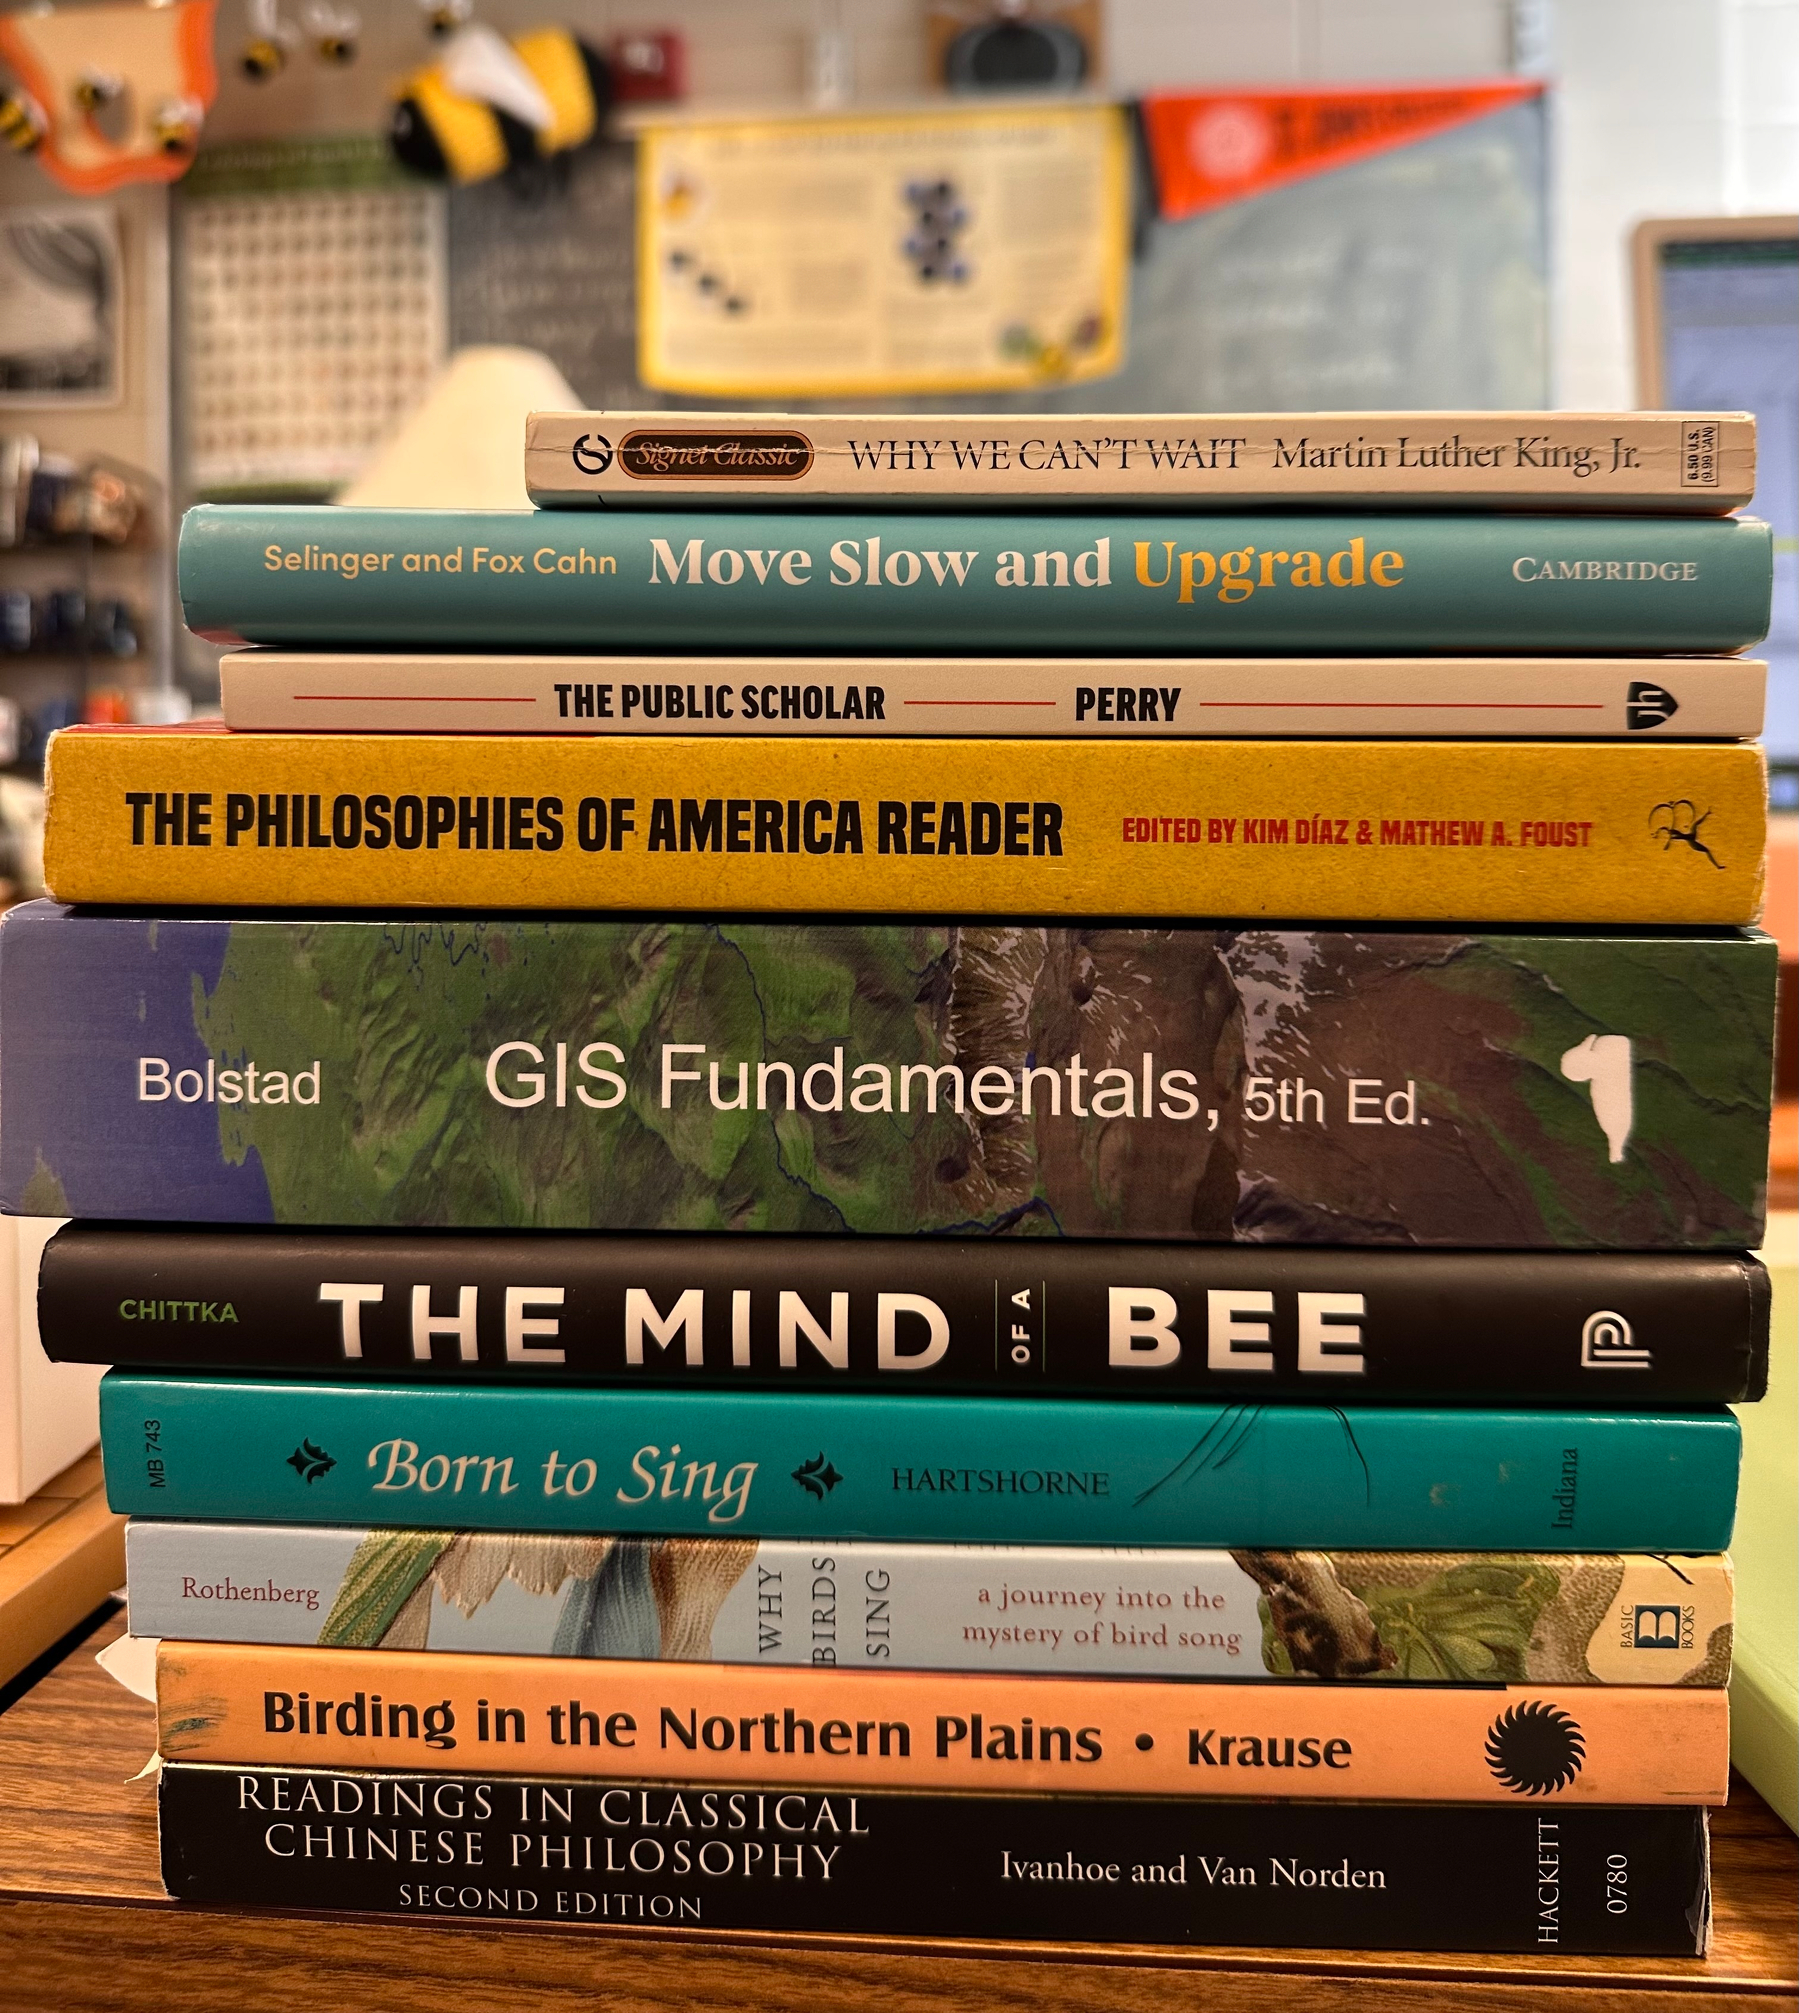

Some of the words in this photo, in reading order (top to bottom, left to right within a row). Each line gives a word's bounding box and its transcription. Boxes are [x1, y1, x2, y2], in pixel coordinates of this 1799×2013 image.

[636, 442, 707, 472] Signet
[713, 441, 797, 466] Classic
[847, 441, 938, 469] WHY
[949, 441, 1010, 469] WE
[1019, 438, 1135, 470] CAN’T
[1145, 438, 1245, 468] WAIT
[1273, 437, 1387, 468] Martin
[1396, 435, 1501, 468] Luther
[1514, 437, 1599, 477] King,
[1610, 438, 1640, 473] Jr.
[265, 544, 394, 579] Selinger
[402, 546, 462, 572] and
[473, 548, 524, 572] Fox
[534, 548, 616, 573] Cahn
[649, 539, 811, 585] Move
[830, 536, 979, 586] Slow
[996, 537, 1111, 586] and
[1133, 538, 1404, 604] Upgrade
[1513, 557, 1697, 581] CAMBRIDGE
[554, 684, 613, 717] THE
[622, 685, 734, 718] PUBLIC
[742, 685, 885, 719] SCHOLAR
[1076, 688, 1181, 721] PERRY
[126, 793, 211, 846] THE
[226, 794, 564, 852] PHILOSOPHIES
[578, 797, 634, 852] OF
[648, 799, 861, 855] AMERICA
[878, 801, 1063, 856] READER
[1123, 816, 1201, 843] EDITED
[1208, 819, 1237, 843] BY
[1244, 819, 1288, 844] KIM
[1295, 813, 1349, 845] DÍAZ
[1356, 820, 1373, 845] &
[1380, 820, 1484, 846] MATHEW
[1490, 821, 1513, 846] A.
[1520, 821, 1594, 847] FOUST
[140, 1057, 320, 1104] Bolstad
[485, 1041, 626, 1108] GIS
[662, 1044, 1219, 1131] Fundamentals,
[1245, 1078, 1324, 1124] 5th
[1348, 1079, 1429, 1125] Ed.
[120, 1299, 238, 1322] CHITTKA
[1012, 1289, 1030, 1309] A
[319, 1283, 565, 1362] THE
[625, 1289, 949, 1369] MIND
[1012, 1325, 1030, 1363] OF
[1109, 1287, 1365, 1372] BEE
[145, 1420, 162, 1452] 743
[147, 1459, 166, 1488] MB
[368, 1438, 519, 1494] Born
[542, 1450, 597, 1496] to
[617, 1444, 758, 1522] Sing
[891, 1467, 1109, 1495] HARTSHORNE
[1551, 1449, 1577, 1530] Indiana
[182, 1577, 319, 1610] Rothenberg
[758, 1565, 782, 1653] WHY
[812, 1557, 836, 1666] BIRDS
[866, 1569, 889, 1657] SING
[979, 1590, 990, 1602] a
[998, 1584, 1104, 1613] journey
[1118, 1587, 1171, 1607] into
[1184, 1586, 1224, 1609] the
[963, 1626, 1062, 1650] mystery
[1074, 1622, 1103, 1644] of
[1112, 1623, 1167, 1646] bird
[1179, 1633, 1241, 1656] song
[1620, 1605, 1633, 1648] BASIC
[1682, 1606, 1694, 1648] BOOKS
[265, 1692, 456, 1749] Birding
[478, 1700, 525, 1742] in
[547, 1701, 636, 1747] the
[661, 1708, 910, 1756] Northern
[937, 1714, 1102, 1762] Plains
[1189, 1730, 1351, 1768] Krause
[238, 1775, 494, 1820] READINGS
[521, 1787, 572, 1822] IN
[600, 1789, 869, 1834] CLASSICAL
[266, 1824, 483, 1864] CHINESE
[512, 1834, 839, 1879] PHILOSOPHY
[1002, 1851, 1119, 1881] Ivanhoe
[1132, 1855, 1186, 1883] and
[1198, 1857, 1256, 1885] Van
[1270, 1858, 1386, 1888] Norden
[1538, 1818, 1559, 1942] HACKETT
[1607, 1855, 1627, 1913] 0780
[400, 1884, 537, 1911] SECOND
[556, 1892, 700, 1919] EDITION
